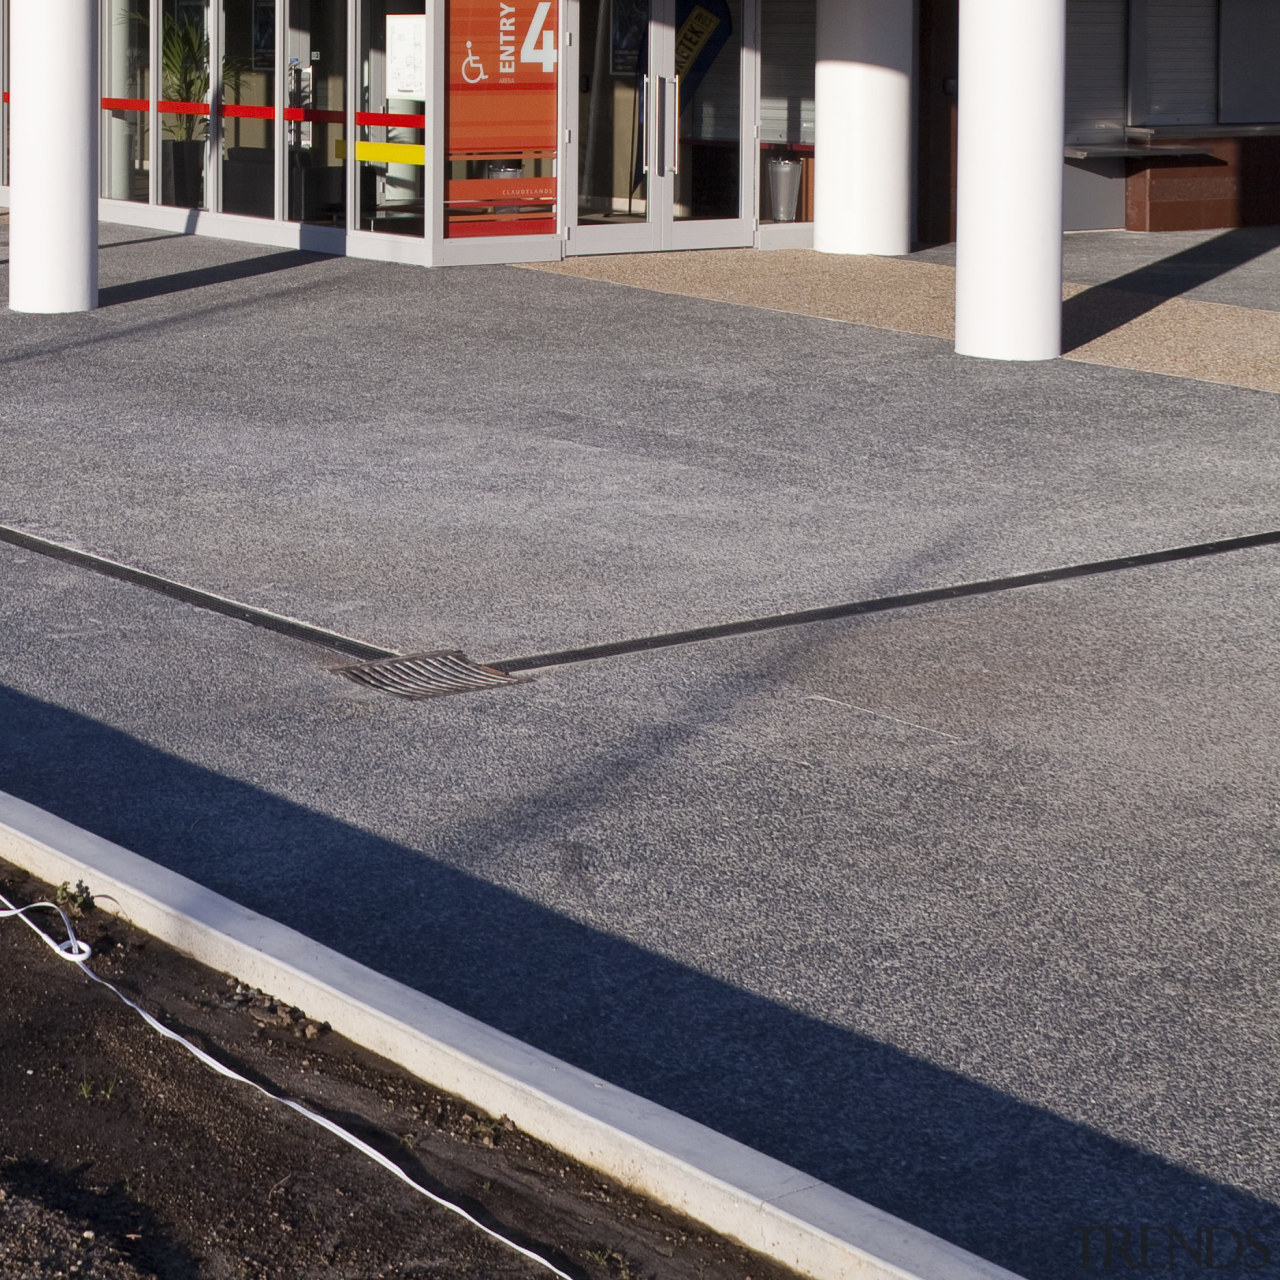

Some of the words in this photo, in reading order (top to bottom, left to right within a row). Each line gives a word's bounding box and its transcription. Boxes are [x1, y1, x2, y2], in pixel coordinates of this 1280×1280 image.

[499, 2, 515, 73] ENTRY
[520, 1, 558, 73] 4
[502, 187, 553, 196] CLAUDELANDS
